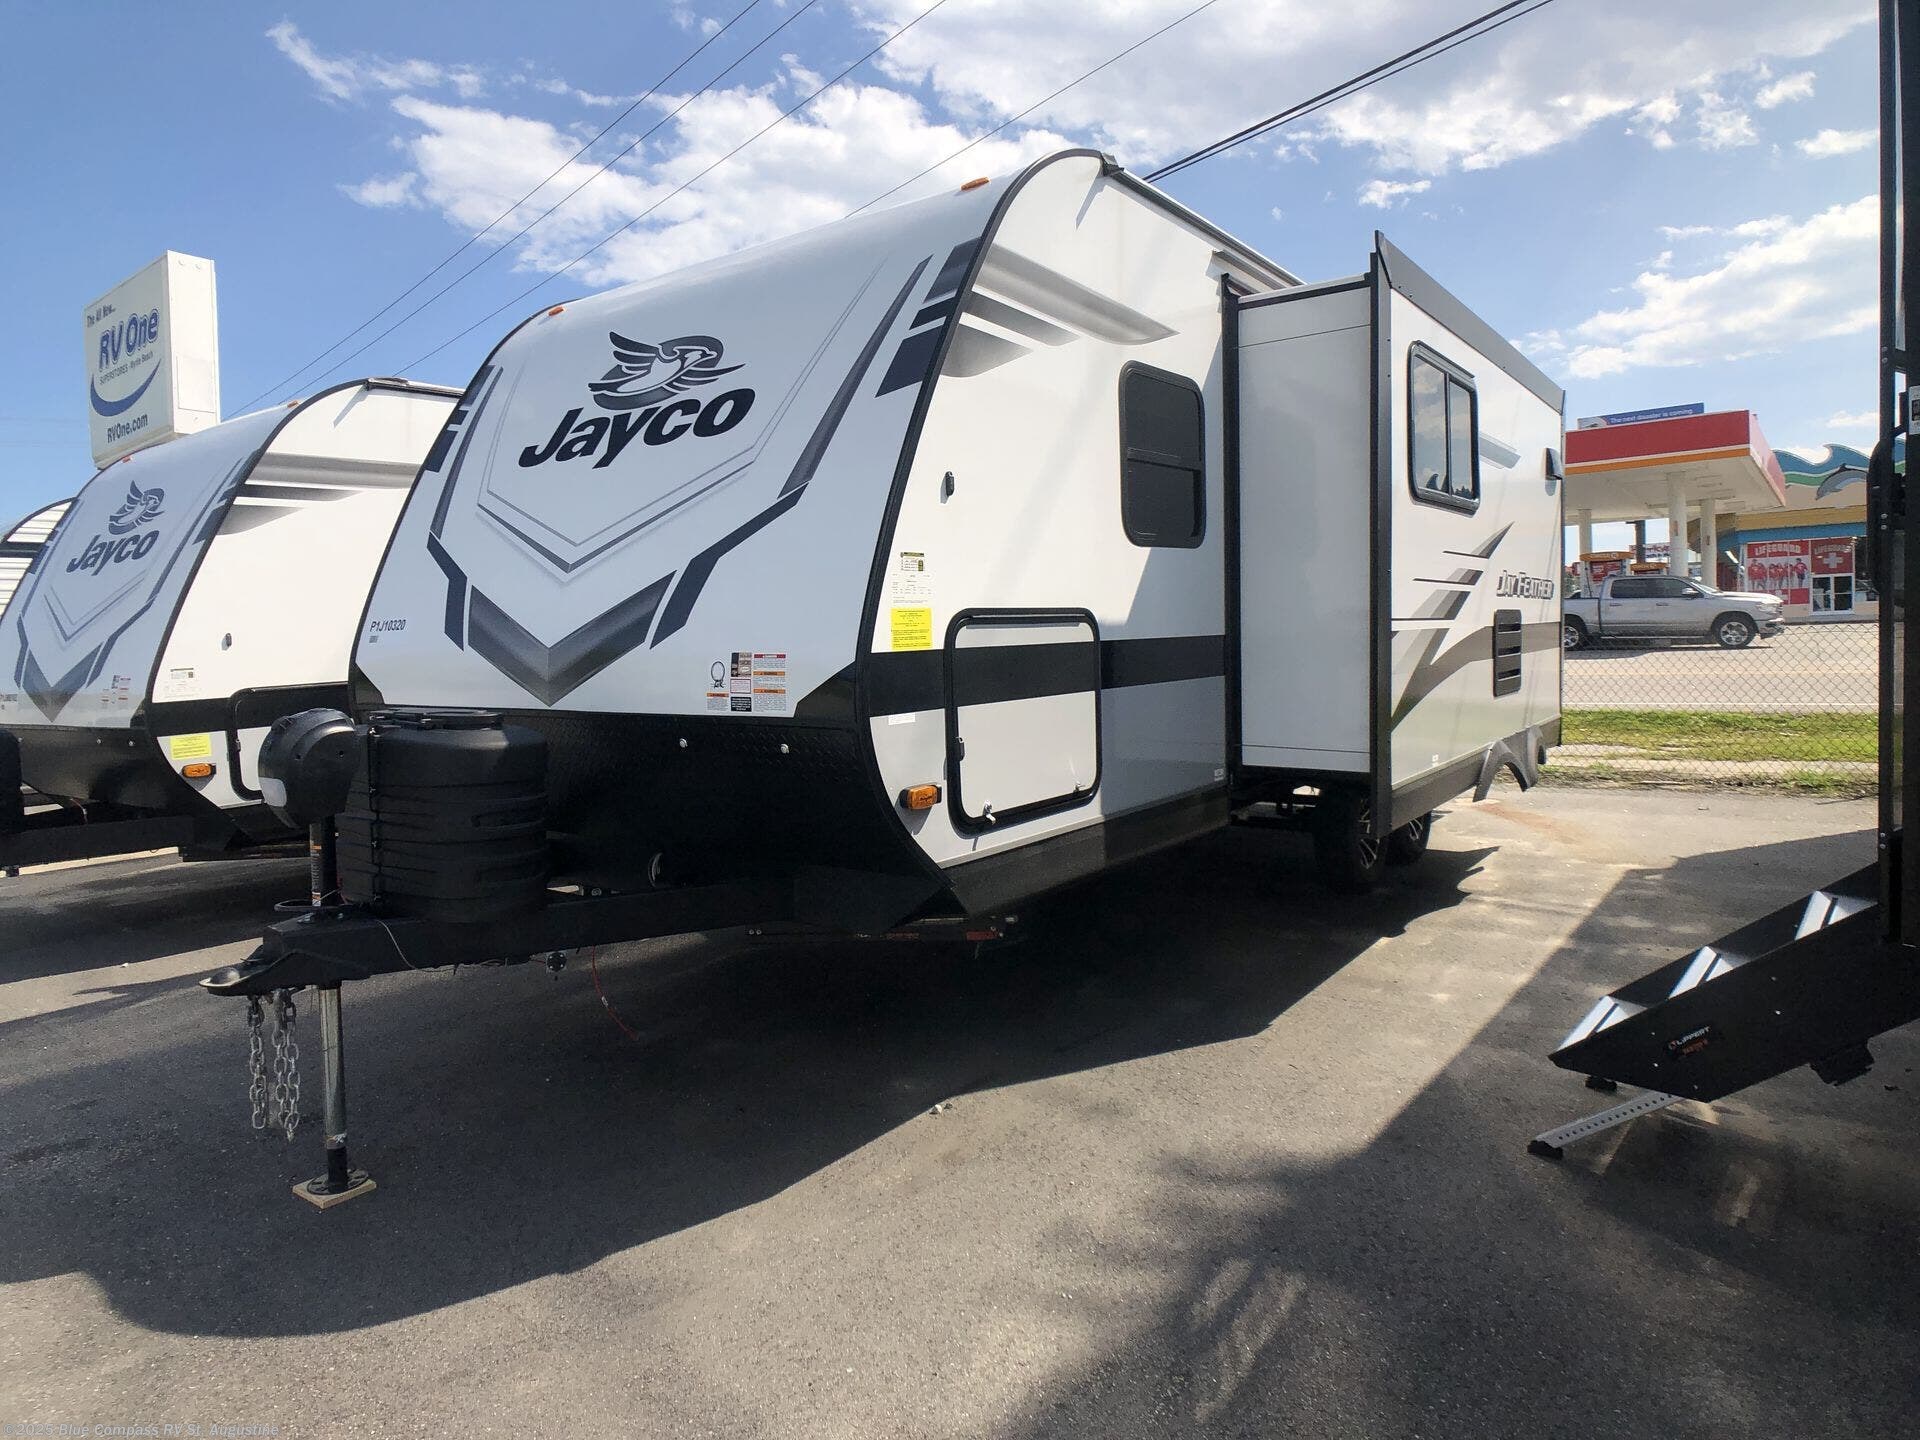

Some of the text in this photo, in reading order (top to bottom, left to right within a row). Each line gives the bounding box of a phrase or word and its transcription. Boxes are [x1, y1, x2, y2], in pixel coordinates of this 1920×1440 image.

[99, 308, 159, 372] RV One
[107, 413, 148, 443] RVOne.com
[518, 388, 756, 469] Jayco
[66, 530, 160, 576] Jayco
[1754, 543, 1801, 556] LIFEGUARD
